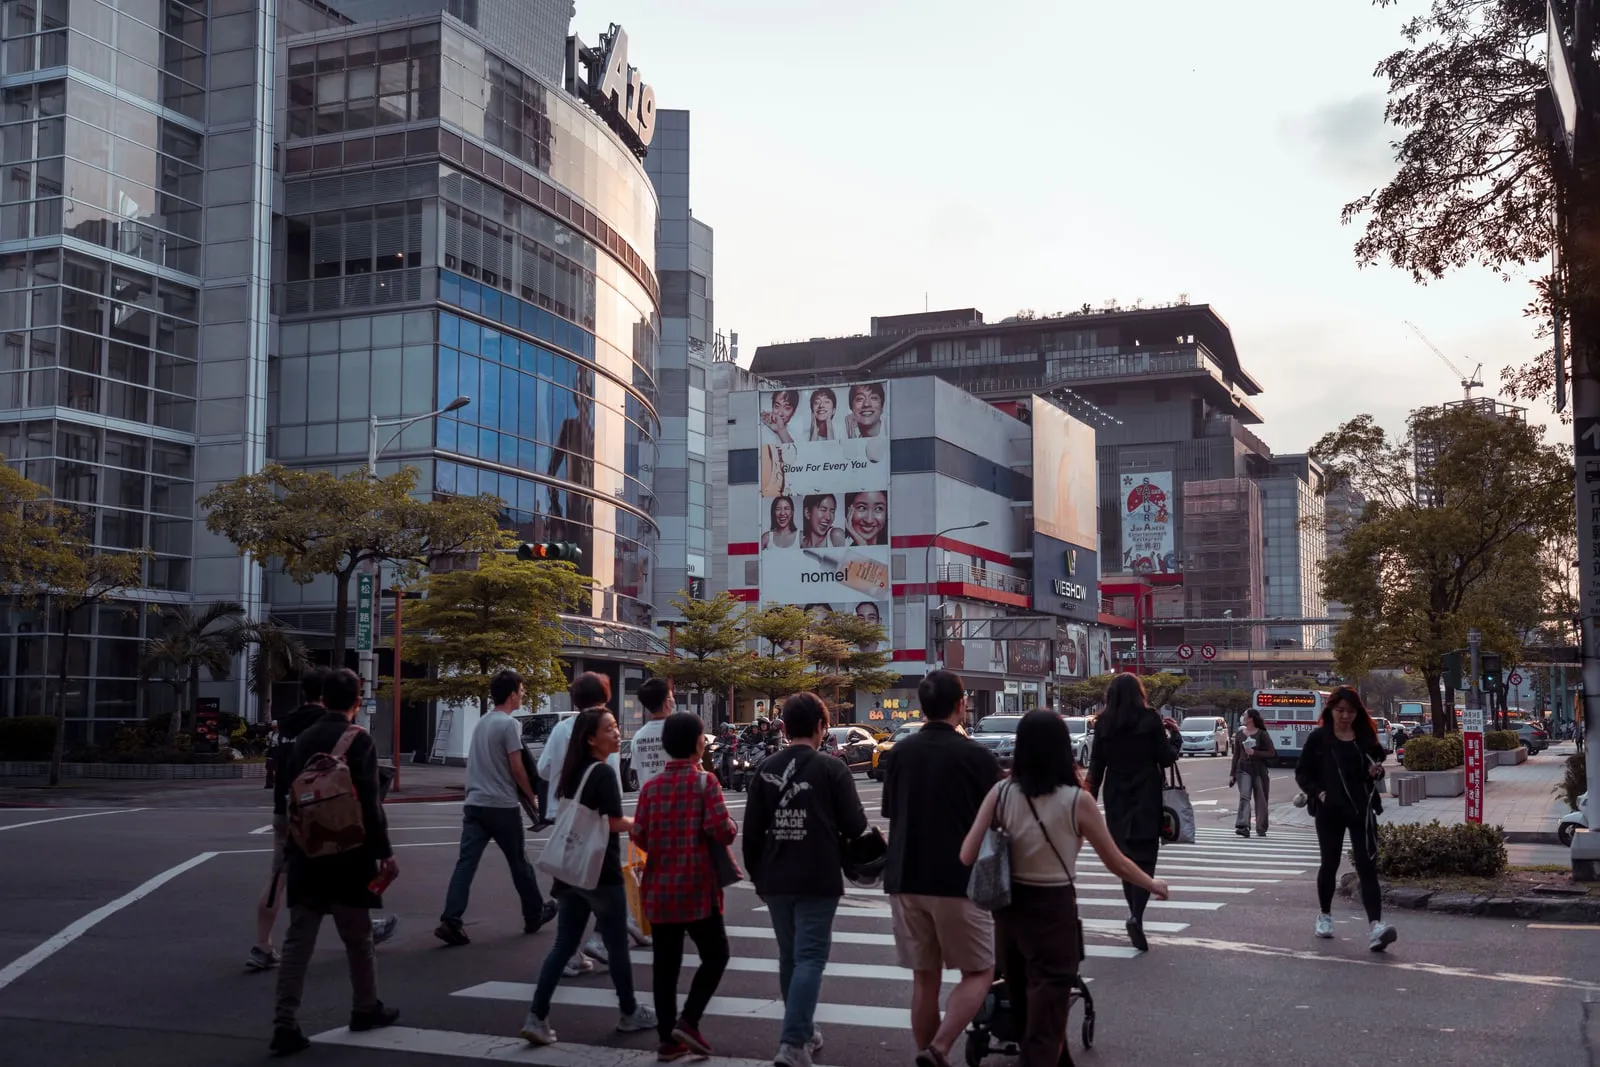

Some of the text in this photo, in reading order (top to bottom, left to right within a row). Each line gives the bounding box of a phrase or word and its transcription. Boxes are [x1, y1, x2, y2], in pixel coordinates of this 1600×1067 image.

[601, 25, 656, 145] A19
[782, 460, 867, 473] Glow For Every You
[801, 568, 848, 583] nomel
[1054, 579, 1087, 601] VIESHOW
[883, 698, 909, 709] NEW
[651, 760, 666, 768] PAST
[774, 808, 807, 818] HUMAN
[775, 818, 804, 828] MADE
